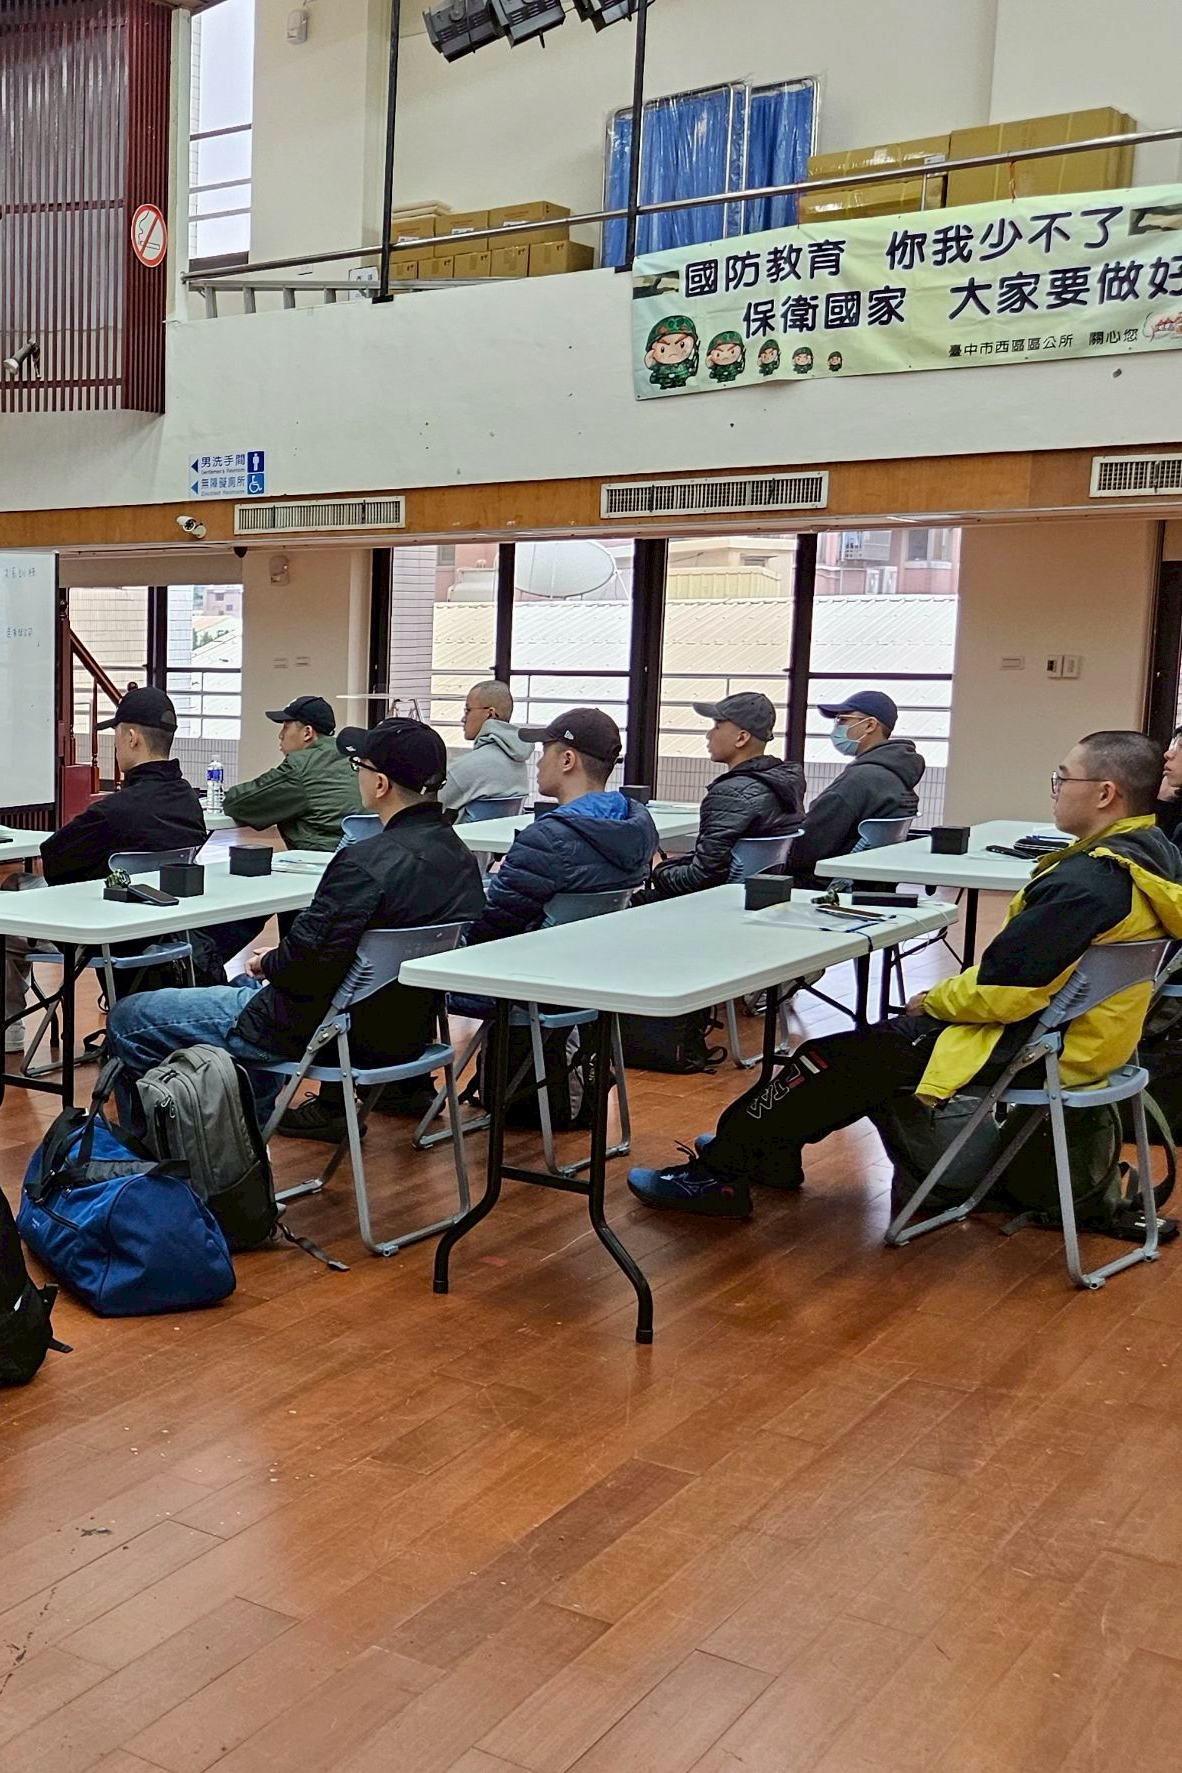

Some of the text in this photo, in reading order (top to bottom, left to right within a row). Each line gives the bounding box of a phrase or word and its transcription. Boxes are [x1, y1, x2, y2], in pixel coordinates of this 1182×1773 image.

[684, 205, 1124, 297] 國防教育 你我少不了
[743, 285, 908, 340] 保衛國家
[1088, 327, 1139, 346] 關心您
[201, 453, 246, 469] 男洗手間
